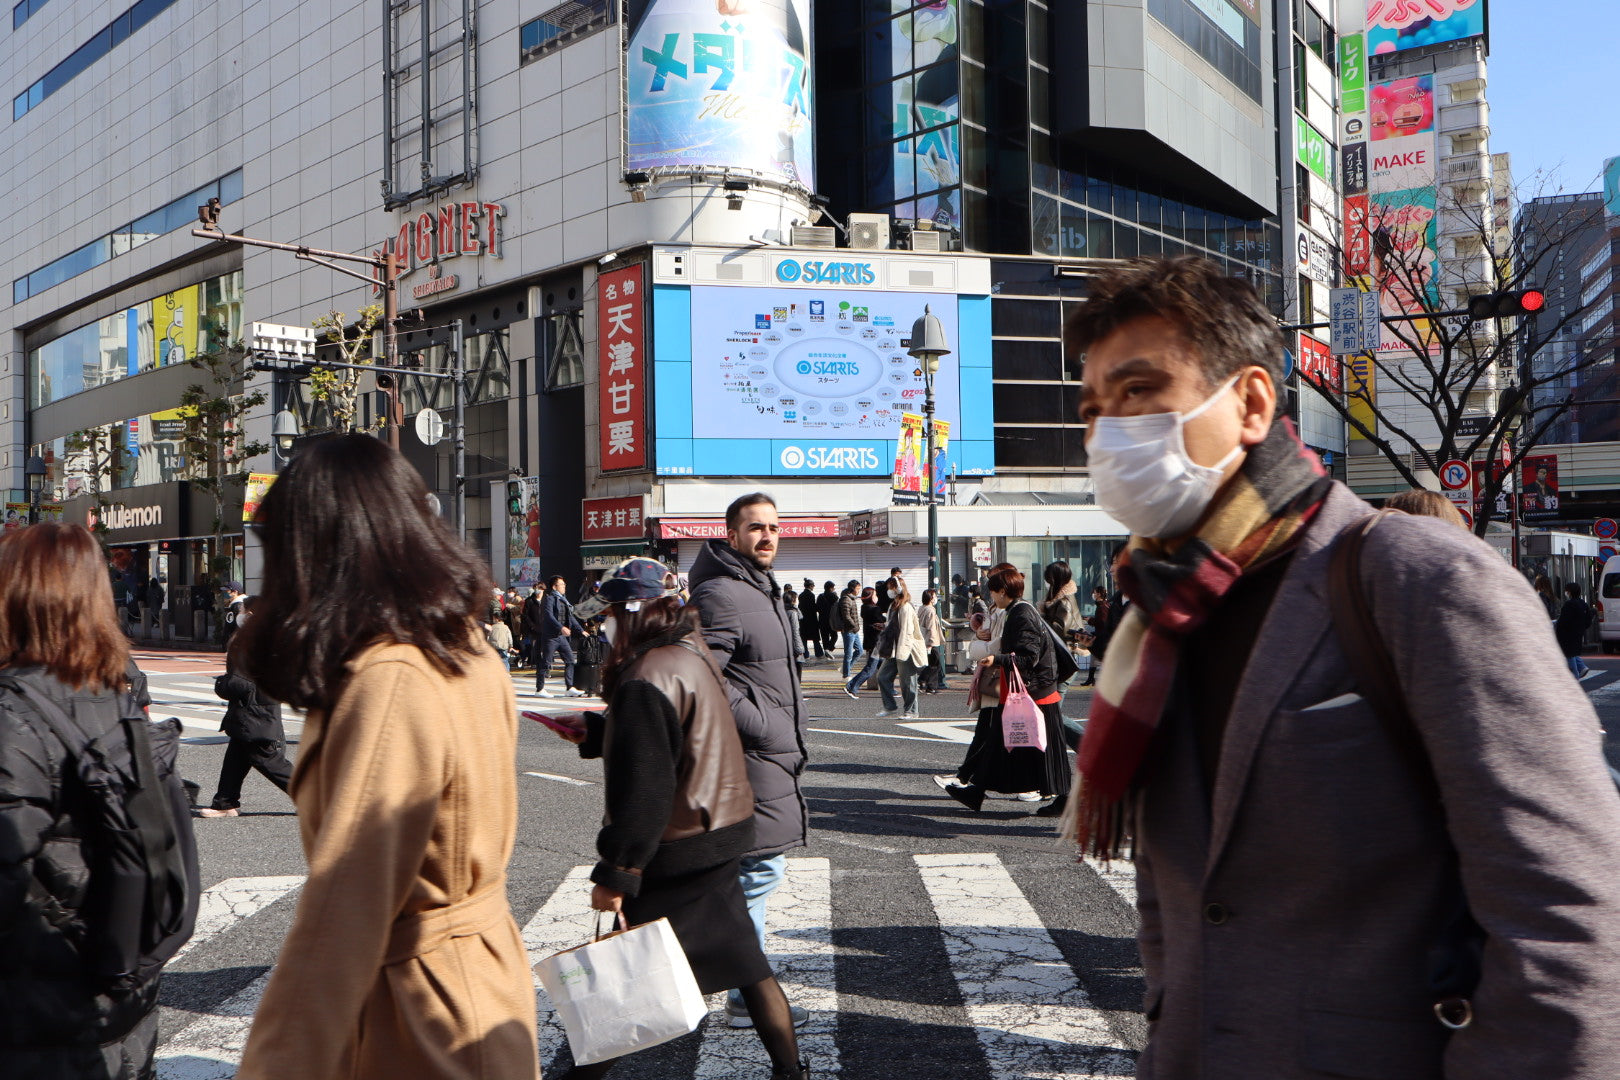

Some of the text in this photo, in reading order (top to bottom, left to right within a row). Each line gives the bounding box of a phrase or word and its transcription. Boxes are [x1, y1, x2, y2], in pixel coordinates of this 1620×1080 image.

[1344, 42, 1359, 81] レイク
[1298, 125, 1323, 164] レイク
[1346, 153, 1354, 186] クリニック
[1350, 223, 1366, 266] アコム
[413, 274, 455, 299] SHIBUYA109
[802, 261, 876, 285] STARTS
[605, 279, 635, 300] 名物
[1333, 302, 1341, 329] Shibuya
[1342, 293, 1357, 349] 渋谷駅前
[1365, 294, 1377, 347] スクランブル式
[1380, 341, 1412, 351] MAK
[813, 361, 860, 375] STARTS
[1303, 347, 1330, 381] アコム
[607, 303, 636, 456] 天津甘栗
[806, 447, 879, 469] STARTS
[101, 504, 162, 530] lululemon
[587, 507, 641, 529] 天津甘栗
